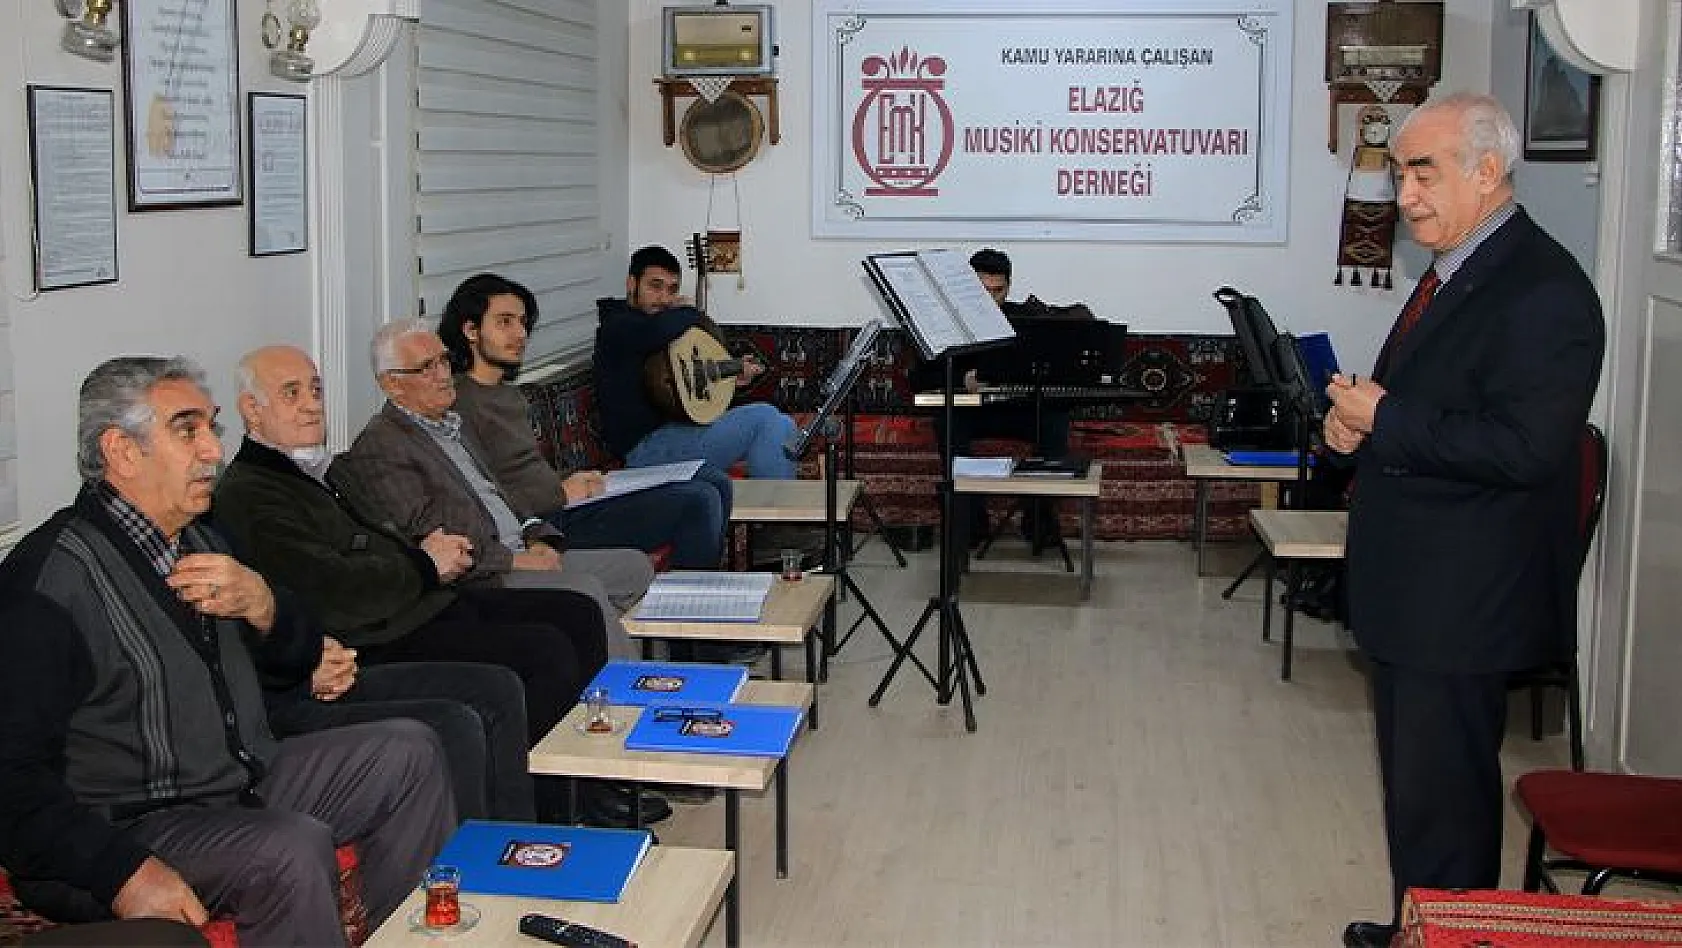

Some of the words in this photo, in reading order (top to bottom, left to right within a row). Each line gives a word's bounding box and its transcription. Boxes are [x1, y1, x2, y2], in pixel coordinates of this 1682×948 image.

[1001, 47, 1050, 65] KAMU
[1054, 47, 1137, 65] YARARINA
[1140, 47, 1213, 69] ÇALIŞAN
[1068, 79, 1144, 114] ELAZIĞ
[964, 119, 1043, 155] MUSİKİ
[1049, 127, 1248, 155] KONSERVATUVARI
[1057, 163, 1152, 196] DERNEĞİ
